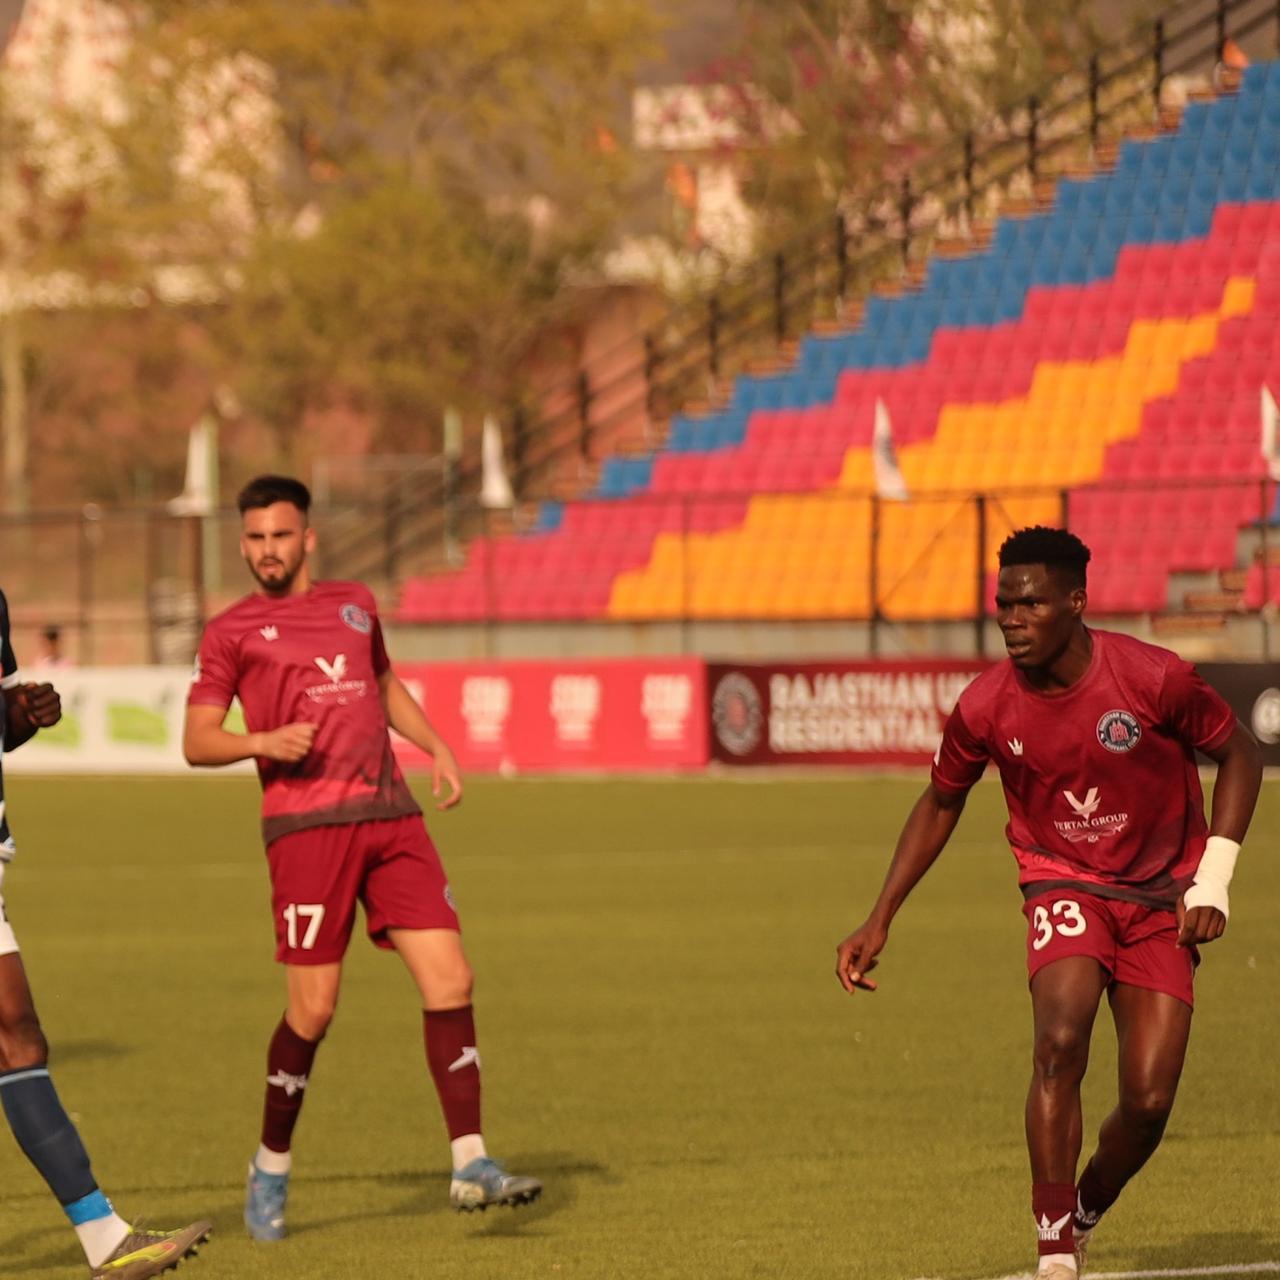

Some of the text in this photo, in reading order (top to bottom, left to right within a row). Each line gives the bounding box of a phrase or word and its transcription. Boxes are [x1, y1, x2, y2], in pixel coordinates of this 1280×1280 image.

[768, 672, 934, 707] RAJASTHAN
[768, 708, 942, 752] RESIDENTIAL
[1091, 812, 1128, 827] GROUP
[283, 903, 325, 950] 17
[1032, 899, 1087, 951] 33
